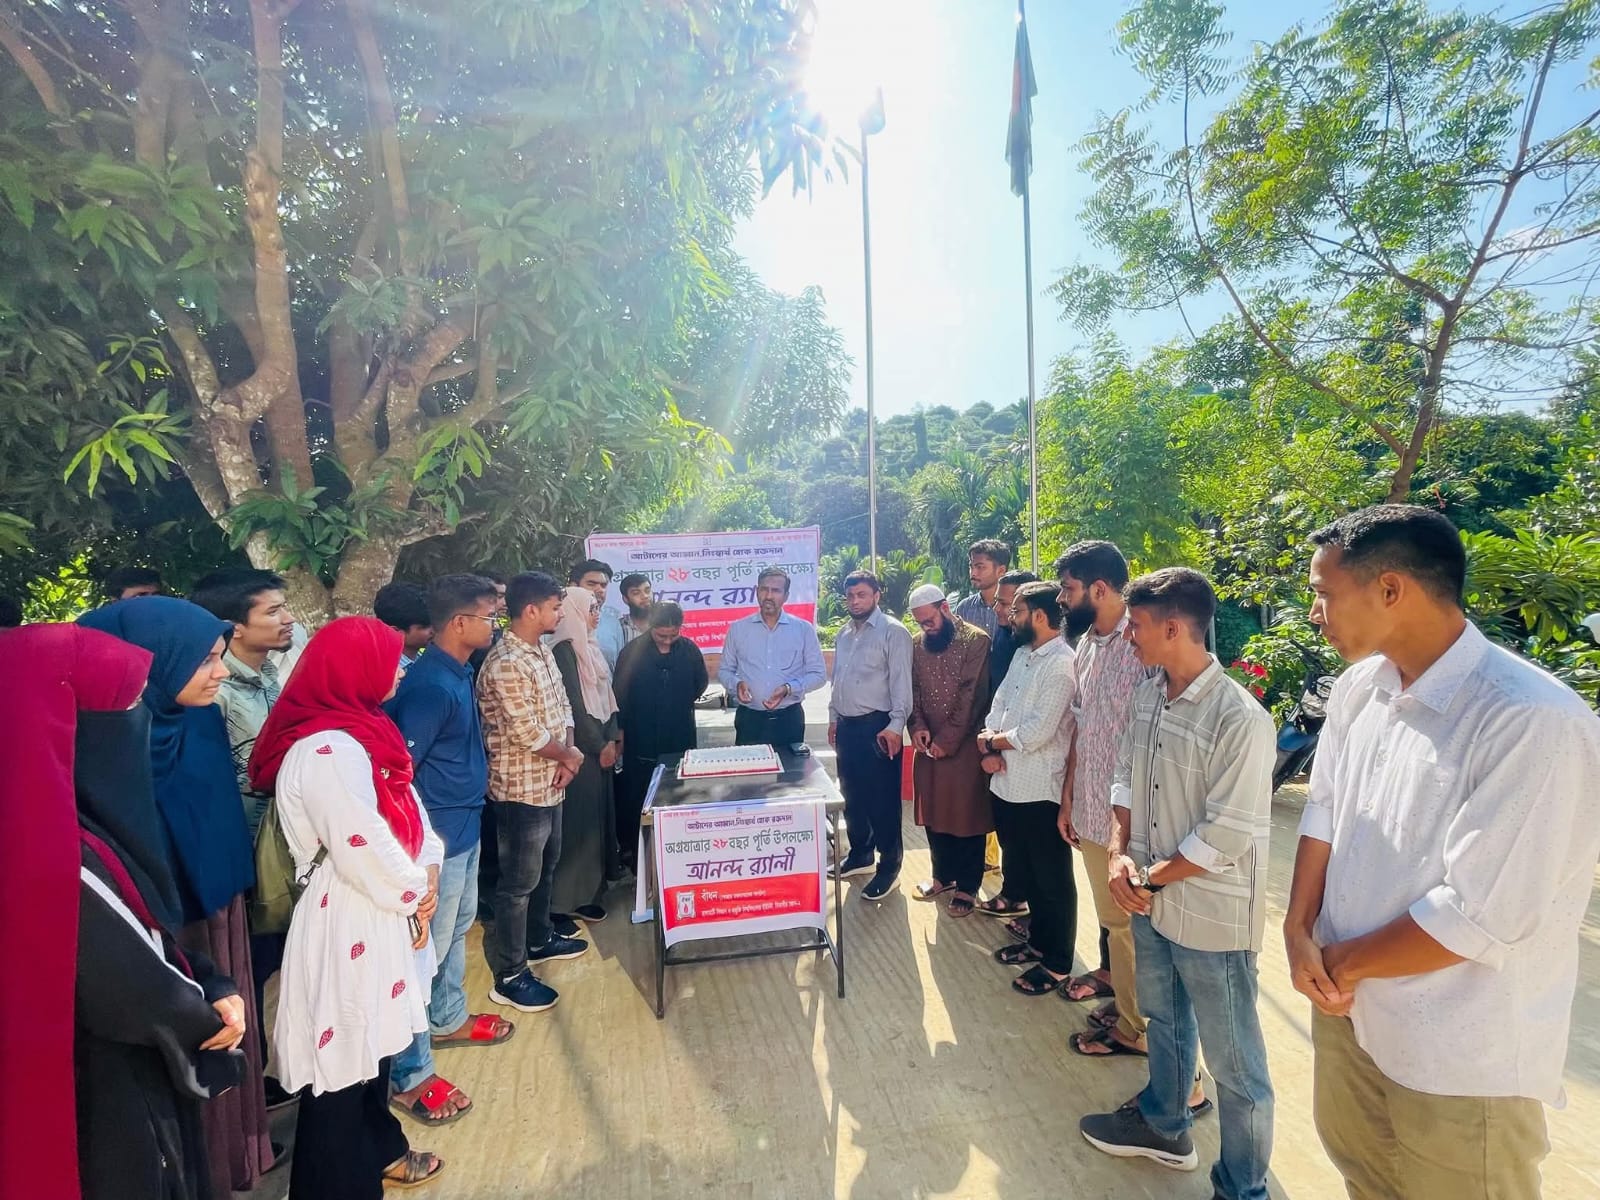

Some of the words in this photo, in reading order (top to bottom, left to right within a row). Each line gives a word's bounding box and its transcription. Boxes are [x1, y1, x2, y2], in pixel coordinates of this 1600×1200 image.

[668, 567, 690, 582] ২৮
[692, 566, 721, 580] বছর
[727, 560, 752, 582] পূর্তি
[665, 839, 711, 854] অগ্রযাত্রার
[712, 838, 728, 849] ২৮
[729, 836, 749, 849] বছর
[752, 829, 771, 852] পূর্তি
[686, 858, 744, 880] আনন্দ
